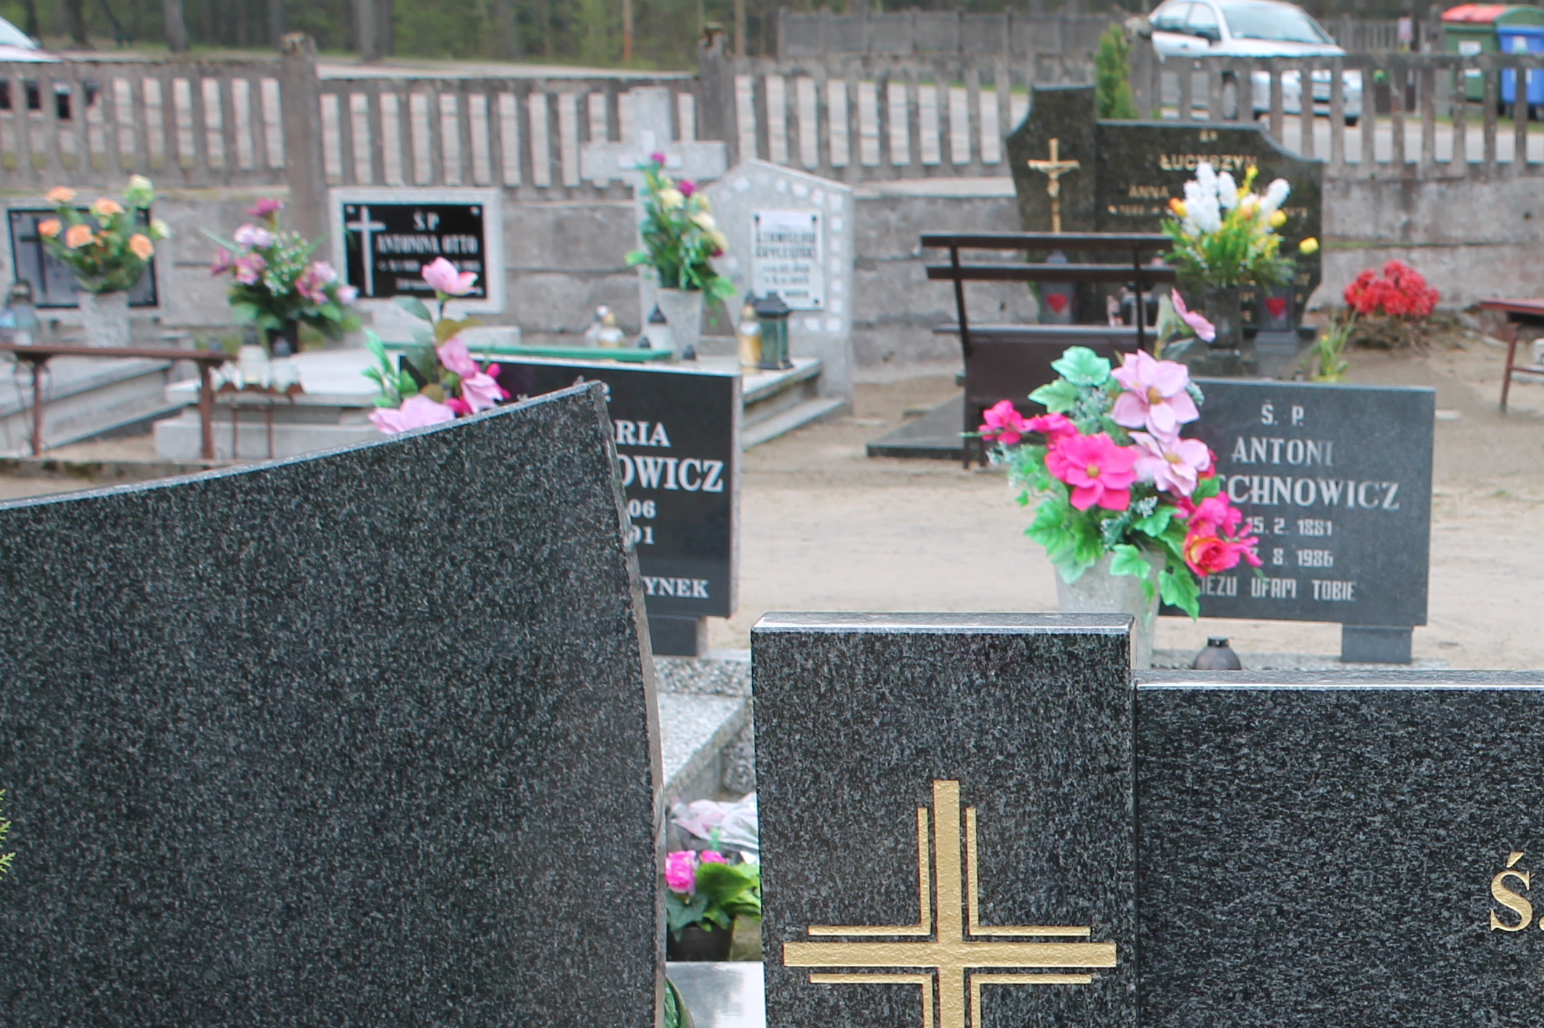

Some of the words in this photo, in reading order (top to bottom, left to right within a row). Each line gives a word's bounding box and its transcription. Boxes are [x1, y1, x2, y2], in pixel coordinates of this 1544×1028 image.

[614, 420, 671, 447] RIA
[1231, 436, 1334, 467] ANTONI
[617, 454, 723, 492] OWICZ
[1221, 474, 1400, 510] CHNOWICZ
[628, 499, 656, 518] 06
[1297, 519, 1332, 537] 1881
[1296, 549, 1334, 568] 1986
[1251, 577, 1297, 599] UFAM
[1311, 579, 1357, 602] TOBIE
